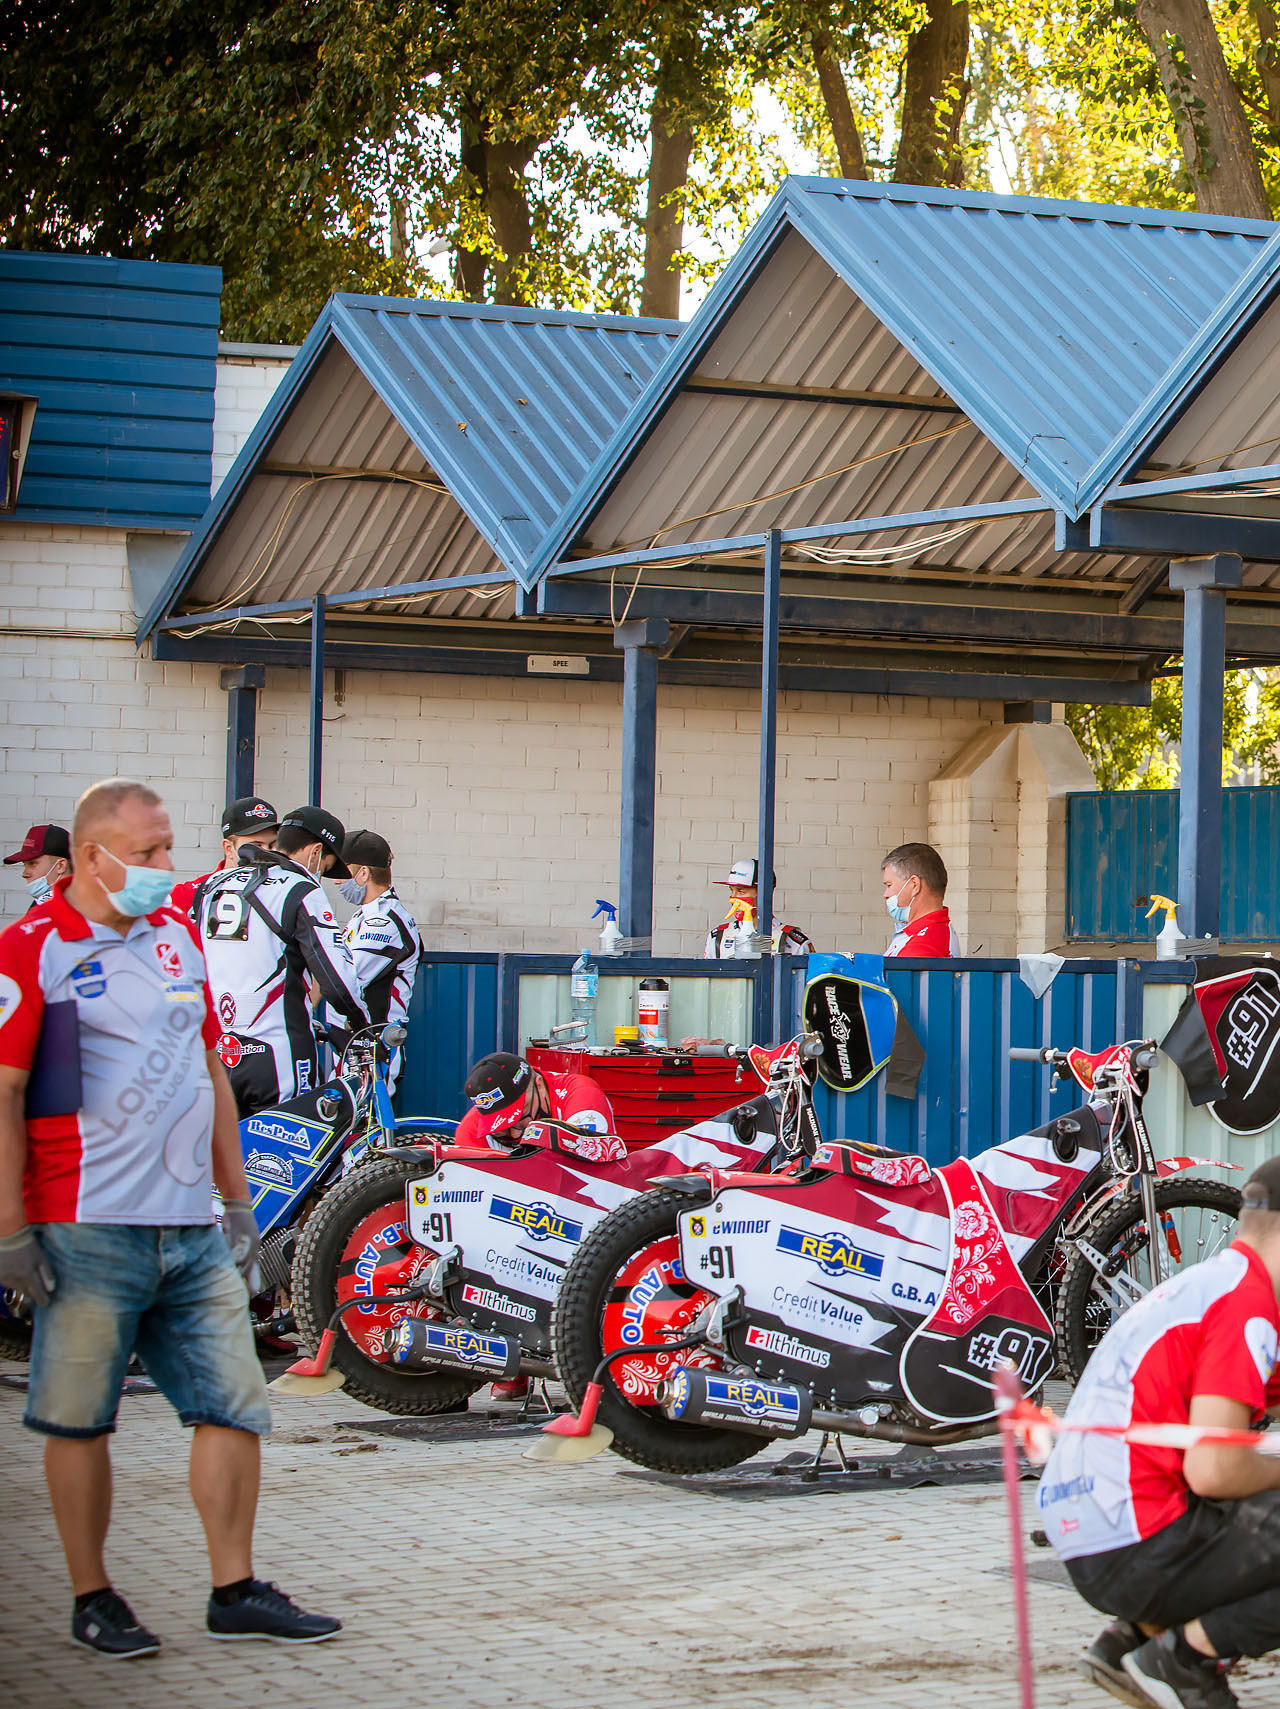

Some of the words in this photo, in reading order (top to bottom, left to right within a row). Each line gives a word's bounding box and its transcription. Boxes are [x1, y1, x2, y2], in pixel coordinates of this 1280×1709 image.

[321, 828, 337, 843] #115
[216, 893, 243, 936] 9
[1226, 981, 1280, 1070] #91
[836, 1043, 853, 1081] WEAR
[422, 1212, 453, 1243] #91
[510, 1205, 566, 1238] REALL
[700, 1246, 735, 1279] #91
[801, 1236, 866, 1272] REALL
[469, 1287, 536, 1322] althimus
[621, 1267, 664, 1345] AUTO
[891, 1282, 922, 1303] G.B.
[444, 1333, 494, 1355] REALL
[753, 1331, 829, 1367] althimus
[967, 1327, 1051, 1385] #91
[727, 1384, 784, 1408] REALL
